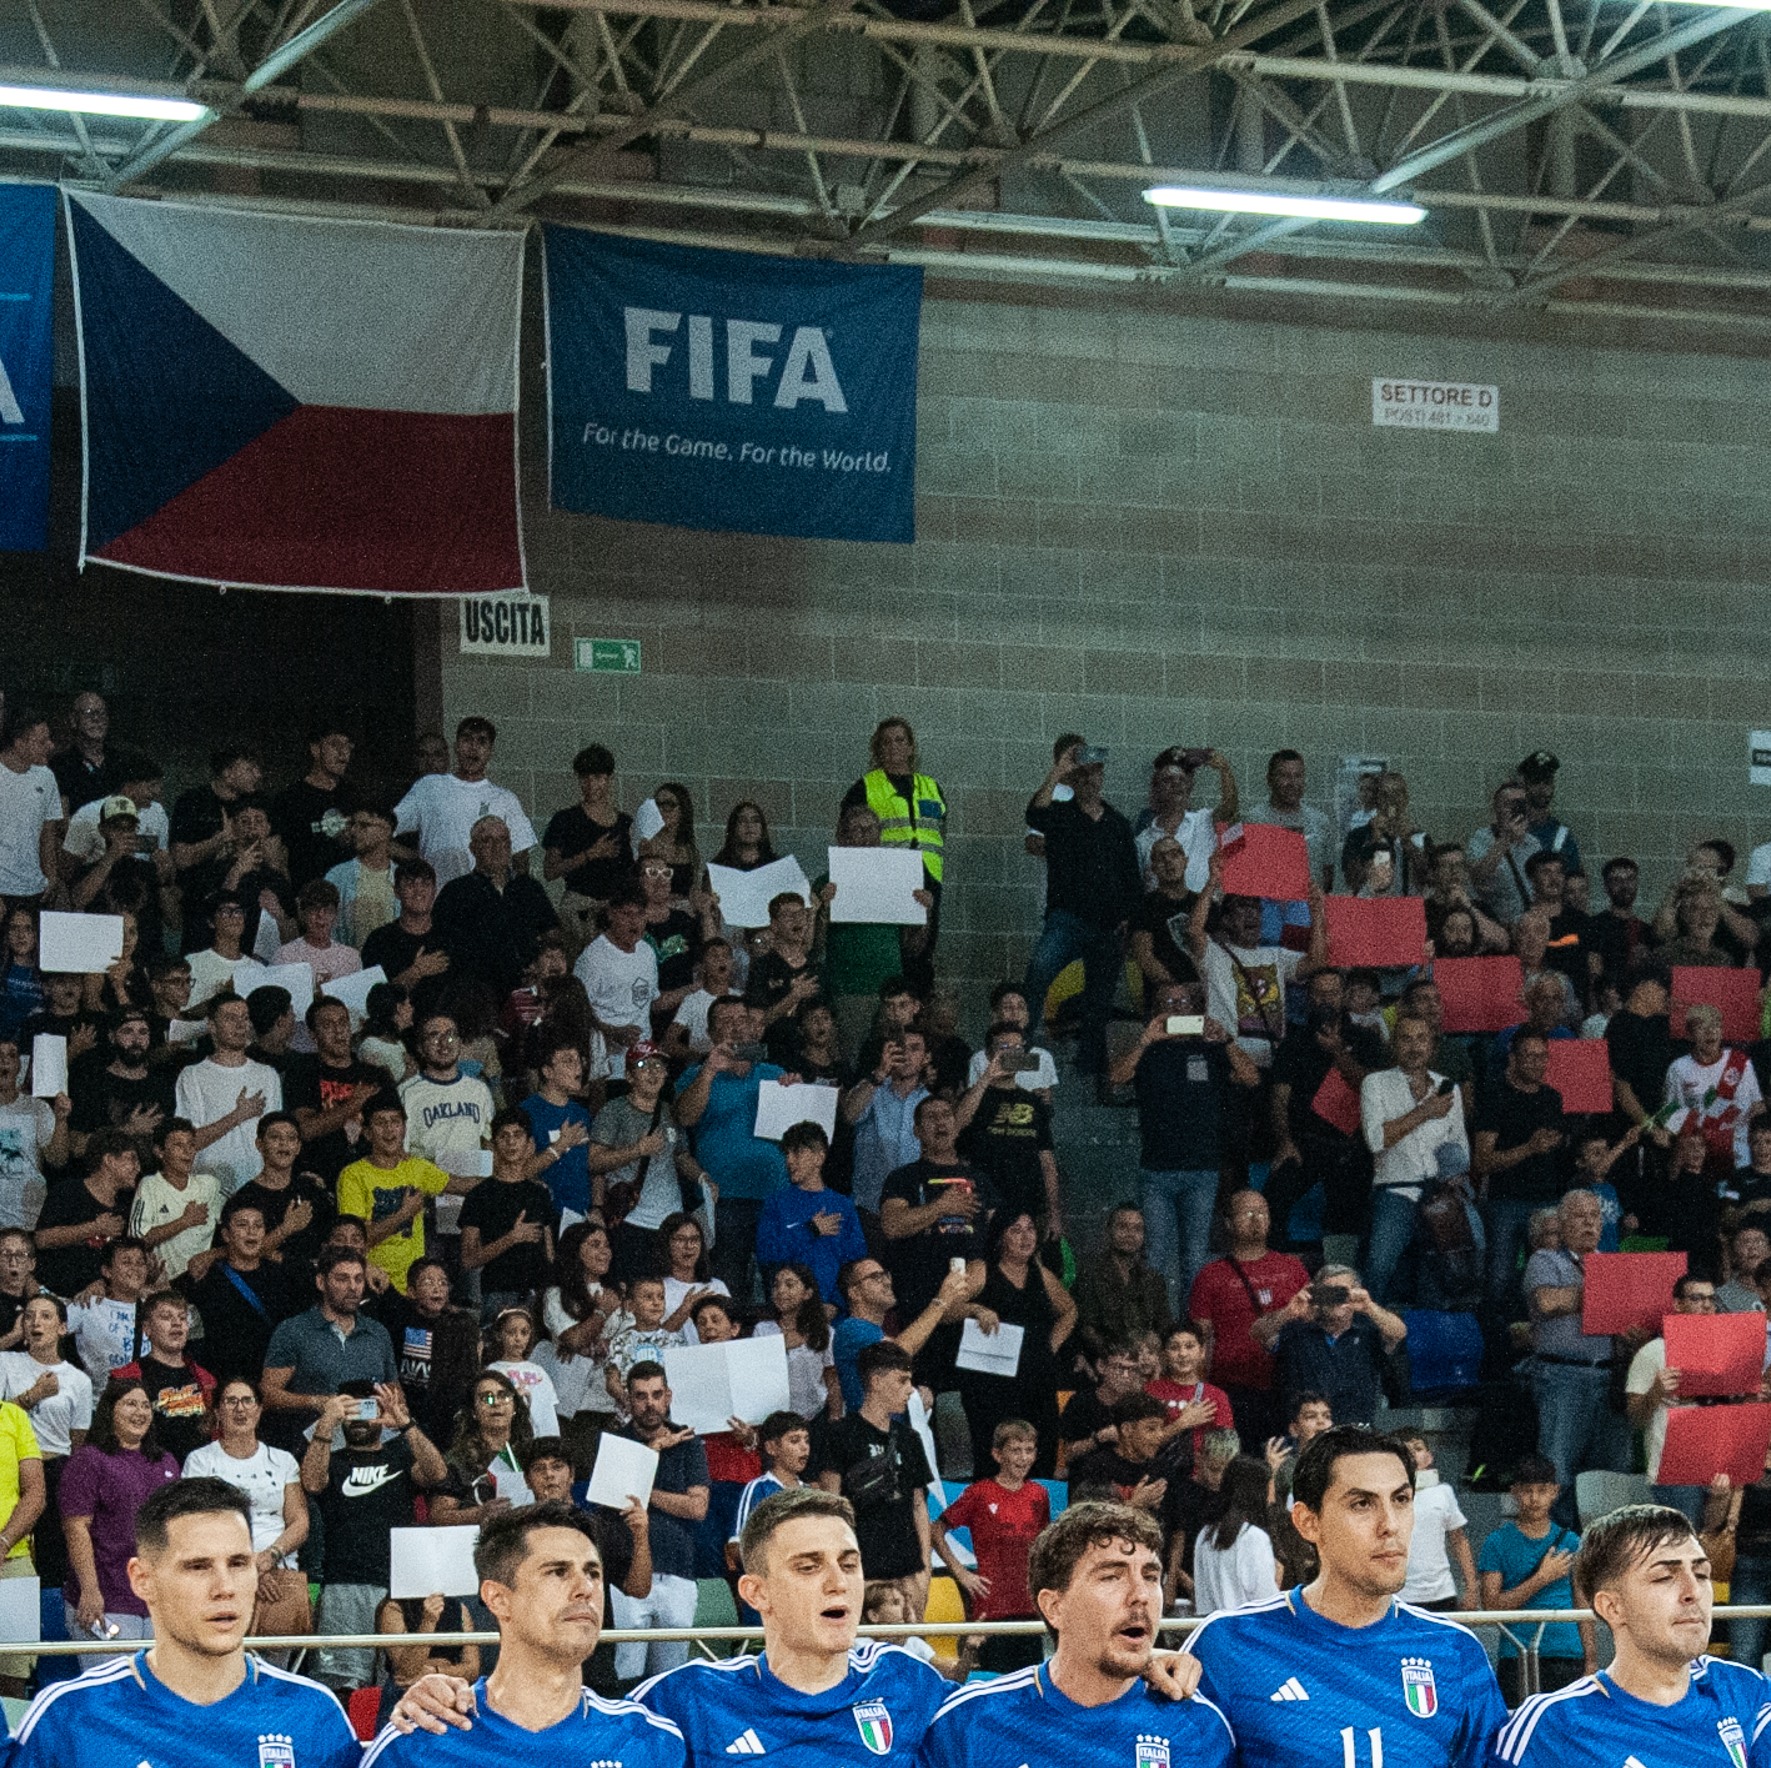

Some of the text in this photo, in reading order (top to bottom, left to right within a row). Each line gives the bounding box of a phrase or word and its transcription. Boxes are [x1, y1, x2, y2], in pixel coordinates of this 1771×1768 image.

[624, 306, 848, 413] FIFA
[1381, 384, 1492, 407] SETTORE D
[582, 422, 892, 474] For the Game. For the World.
[465, 601, 545, 645] USCITA
[422, 1102, 480, 1129] OAKLAND
[351, 1463, 390, 1485] NIKE
[1402, 1667, 1432, 1684] ITALIA
[853, 1704, 887, 1720] ITALIA
[1139, 1748, 1169, 1762] ITALIA
